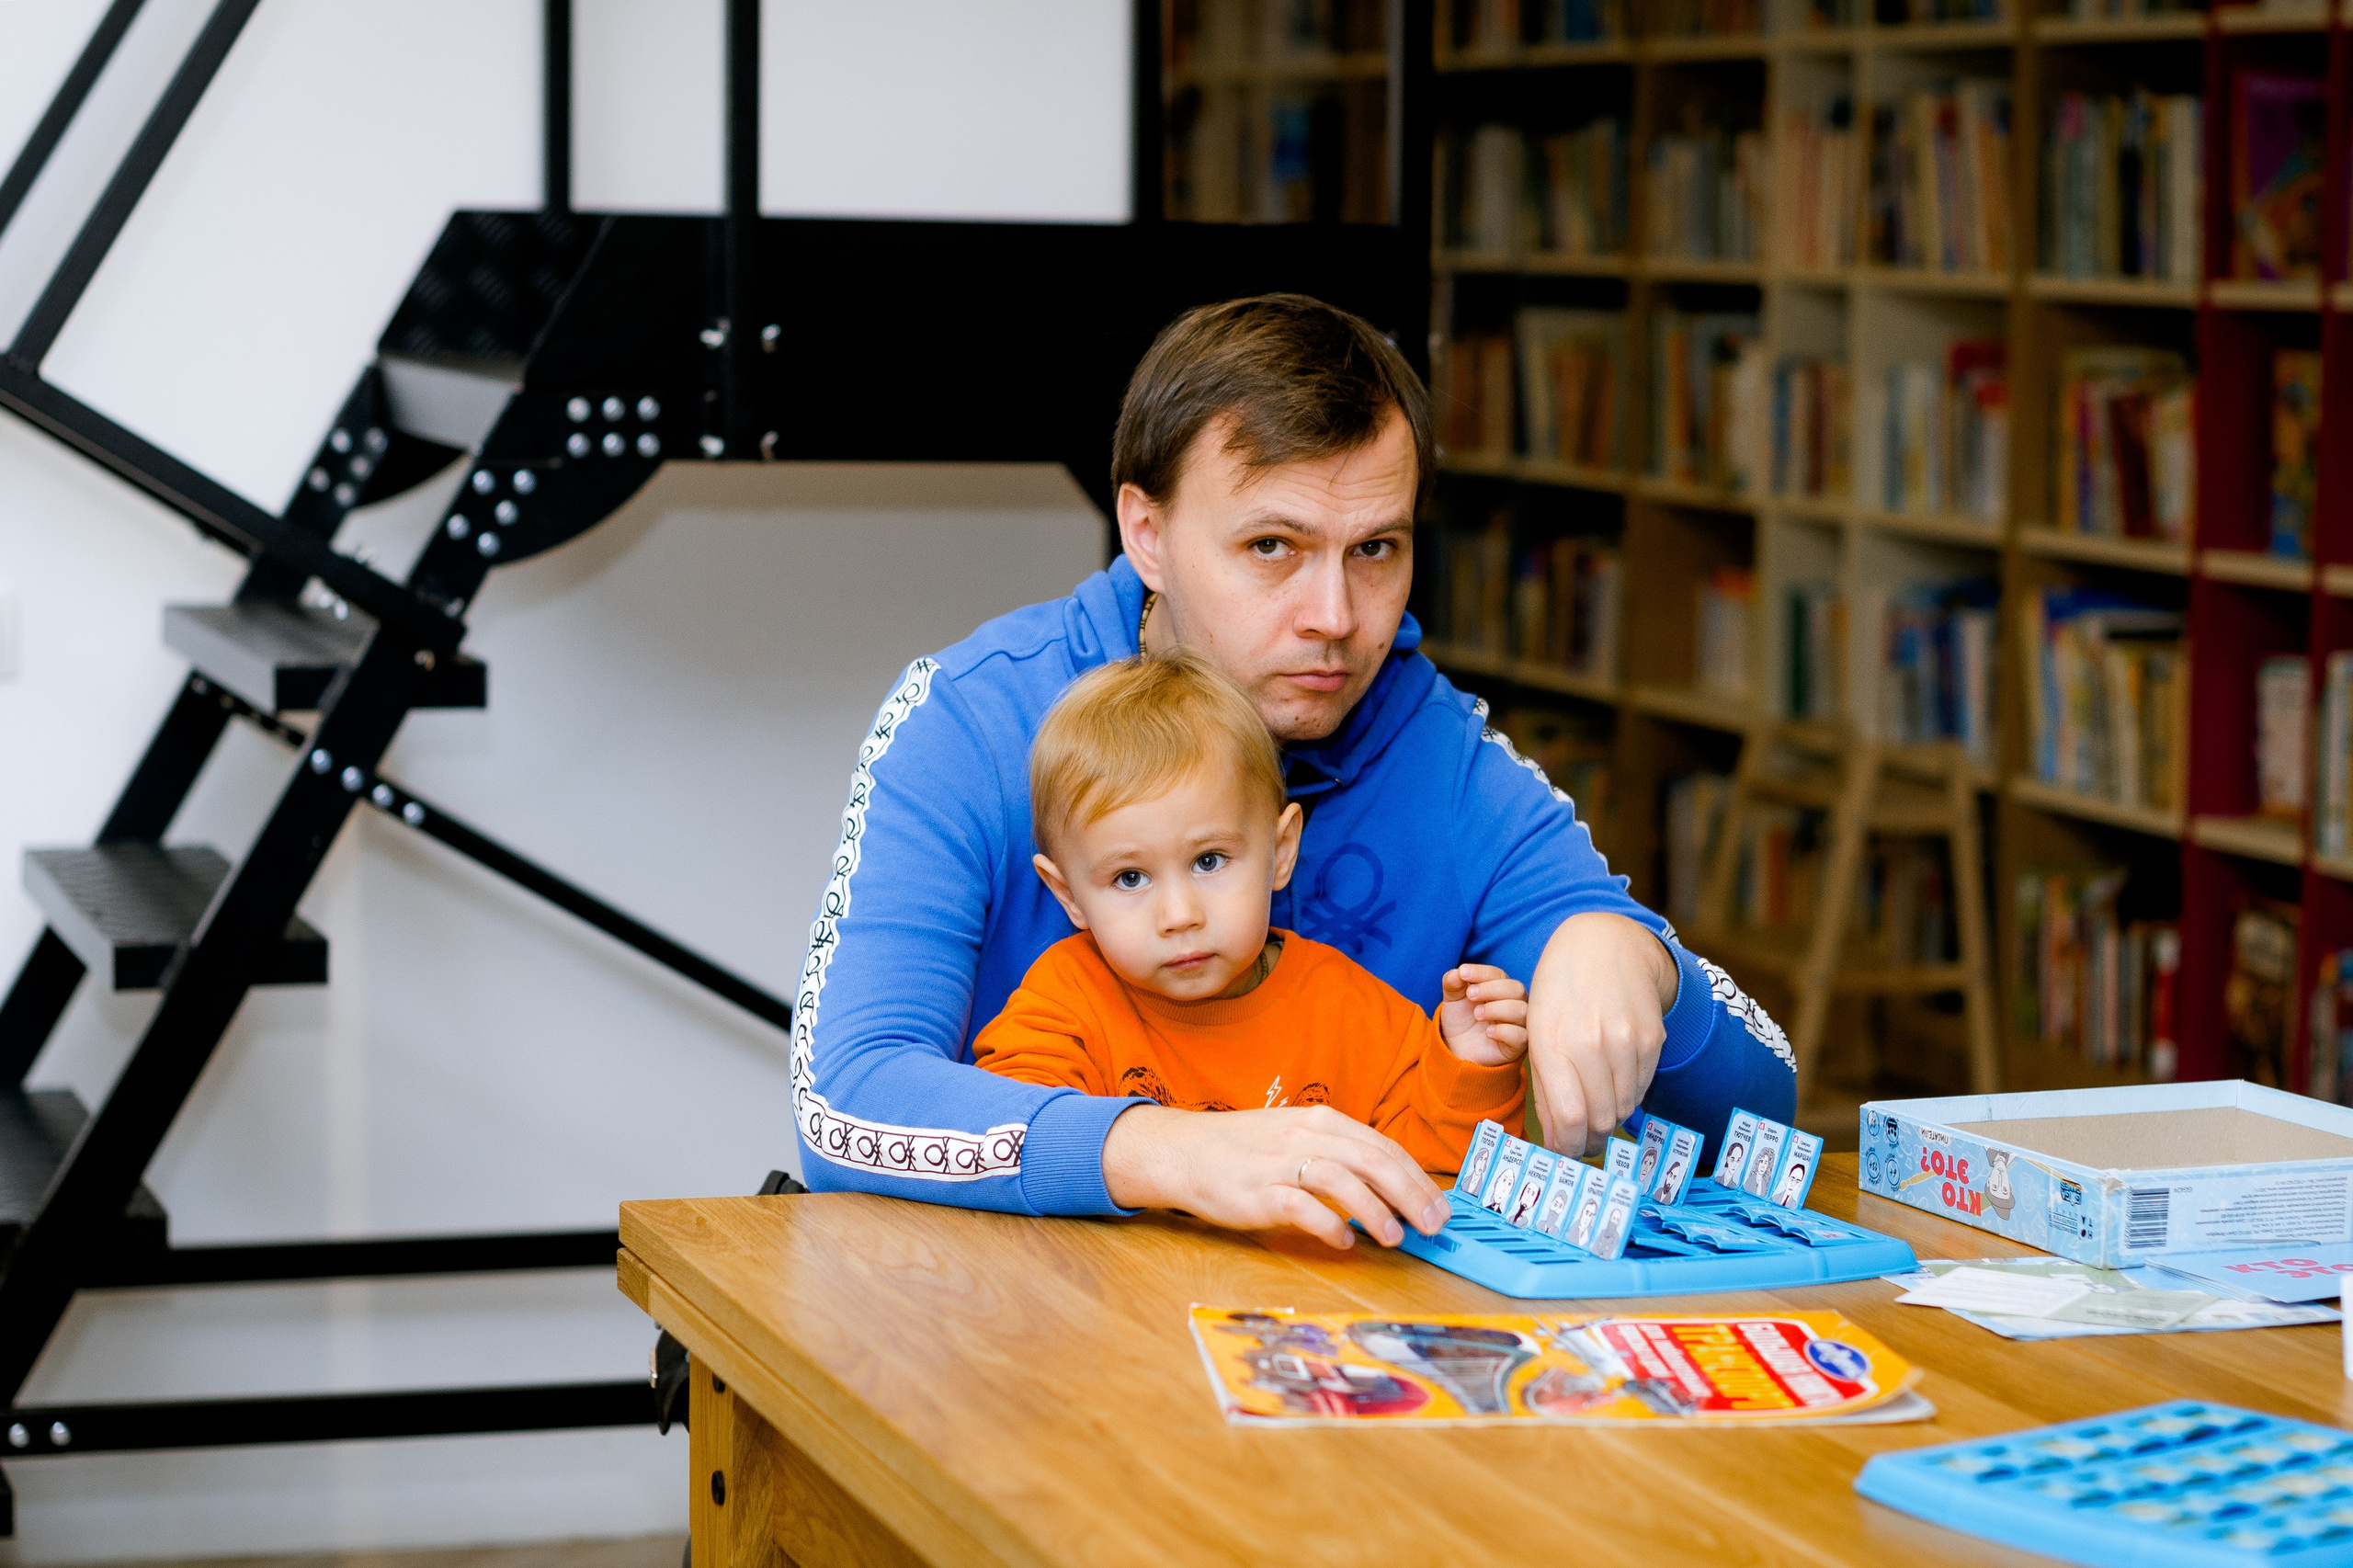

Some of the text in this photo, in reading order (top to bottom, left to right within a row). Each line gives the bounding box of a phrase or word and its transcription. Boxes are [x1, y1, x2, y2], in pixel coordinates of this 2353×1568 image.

[1733, 1131, 1752, 1142] ТЮТЧЕВ
[1764, 1133, 1779, 1143] ПЕРРО
[1921, 1128, 1949, 1144] ПИСАТЕЛИ
[1481, 1136, 1495, 1148] ГОГОЛЬ
[1615, 1158, 1631, 1169] ЧЕХОВ
[1920, 1146, 1970, 1185] ЭТО?
[1889, 1168, 1897, 1177] 6+
[1558, 1176, 1574, 1187] БАЖОВ
[1942, 1181, 1981, 1217] КТО
[2222, 1258, 2319, 1274] КТО
